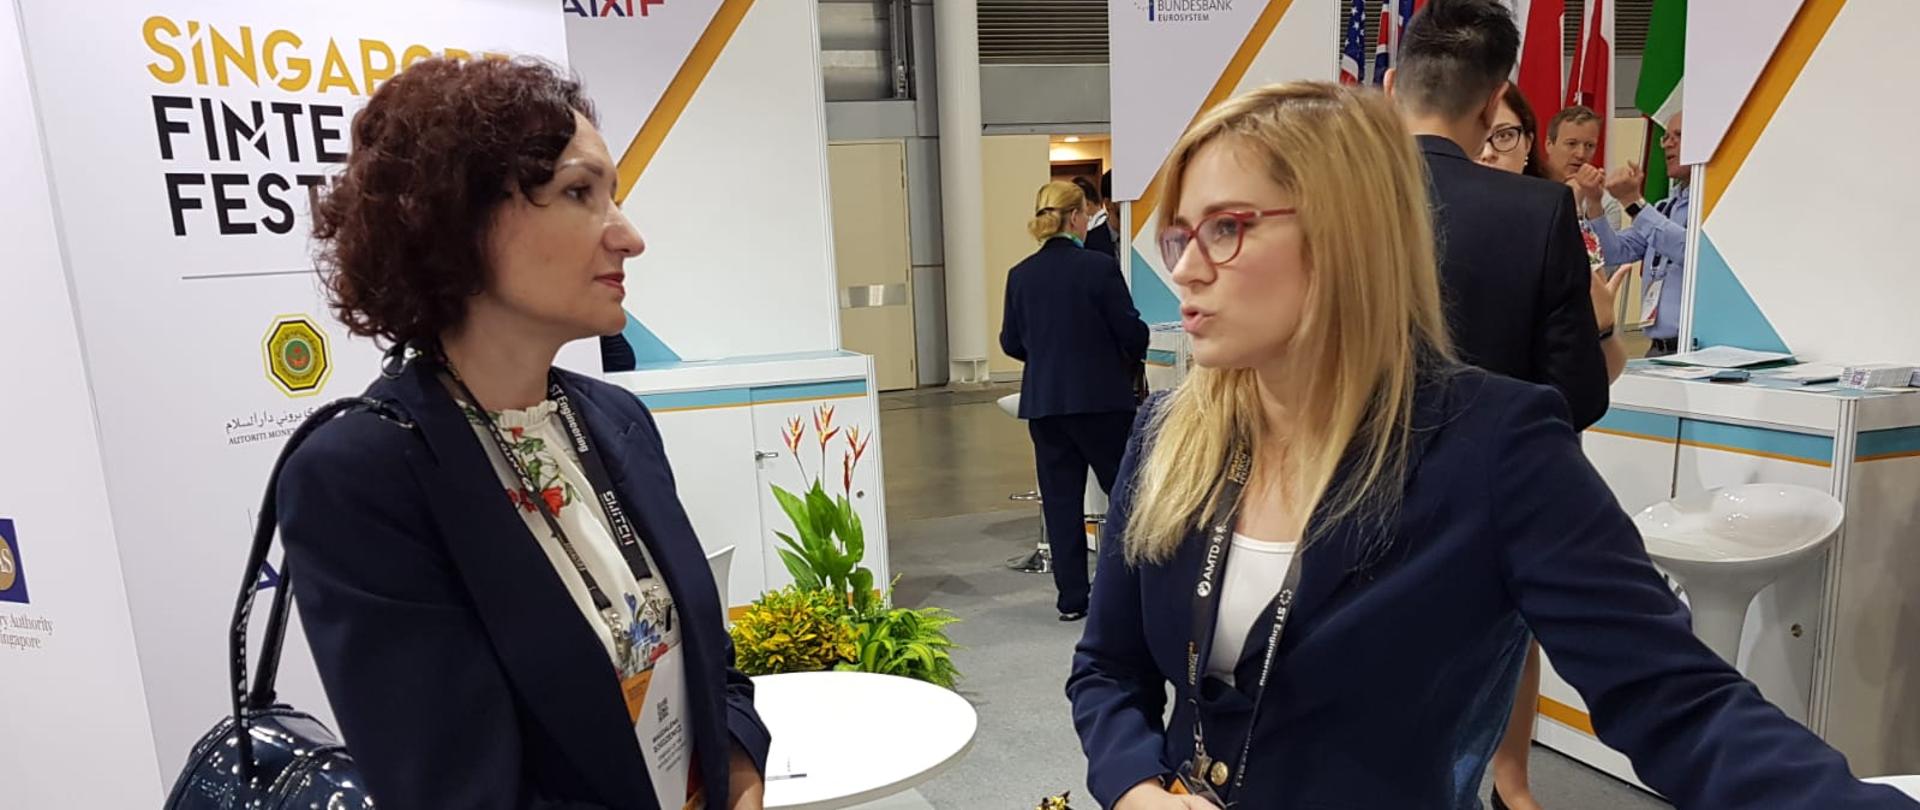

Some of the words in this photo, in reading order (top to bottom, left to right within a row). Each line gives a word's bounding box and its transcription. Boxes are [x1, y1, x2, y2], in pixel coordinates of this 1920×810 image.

[1157, 0, 1233, 11] BUNDESBANK
[142, 16, 510, 97] SINGAP
[152, 95, 349, 163] FINTE
[165, 173, 338, 236] FEST
[229, 432, 267, 445] AUTORITI
[550, 384, 564, 396] ST
[557, 396, 589, 453] Engineering
[603, 490, 635, 545] SWITCH
[1203, 544, 1220, 580] AMTD
[10, 613, 54, 636] Authority
[1276, 607, 1286, 621] ST
